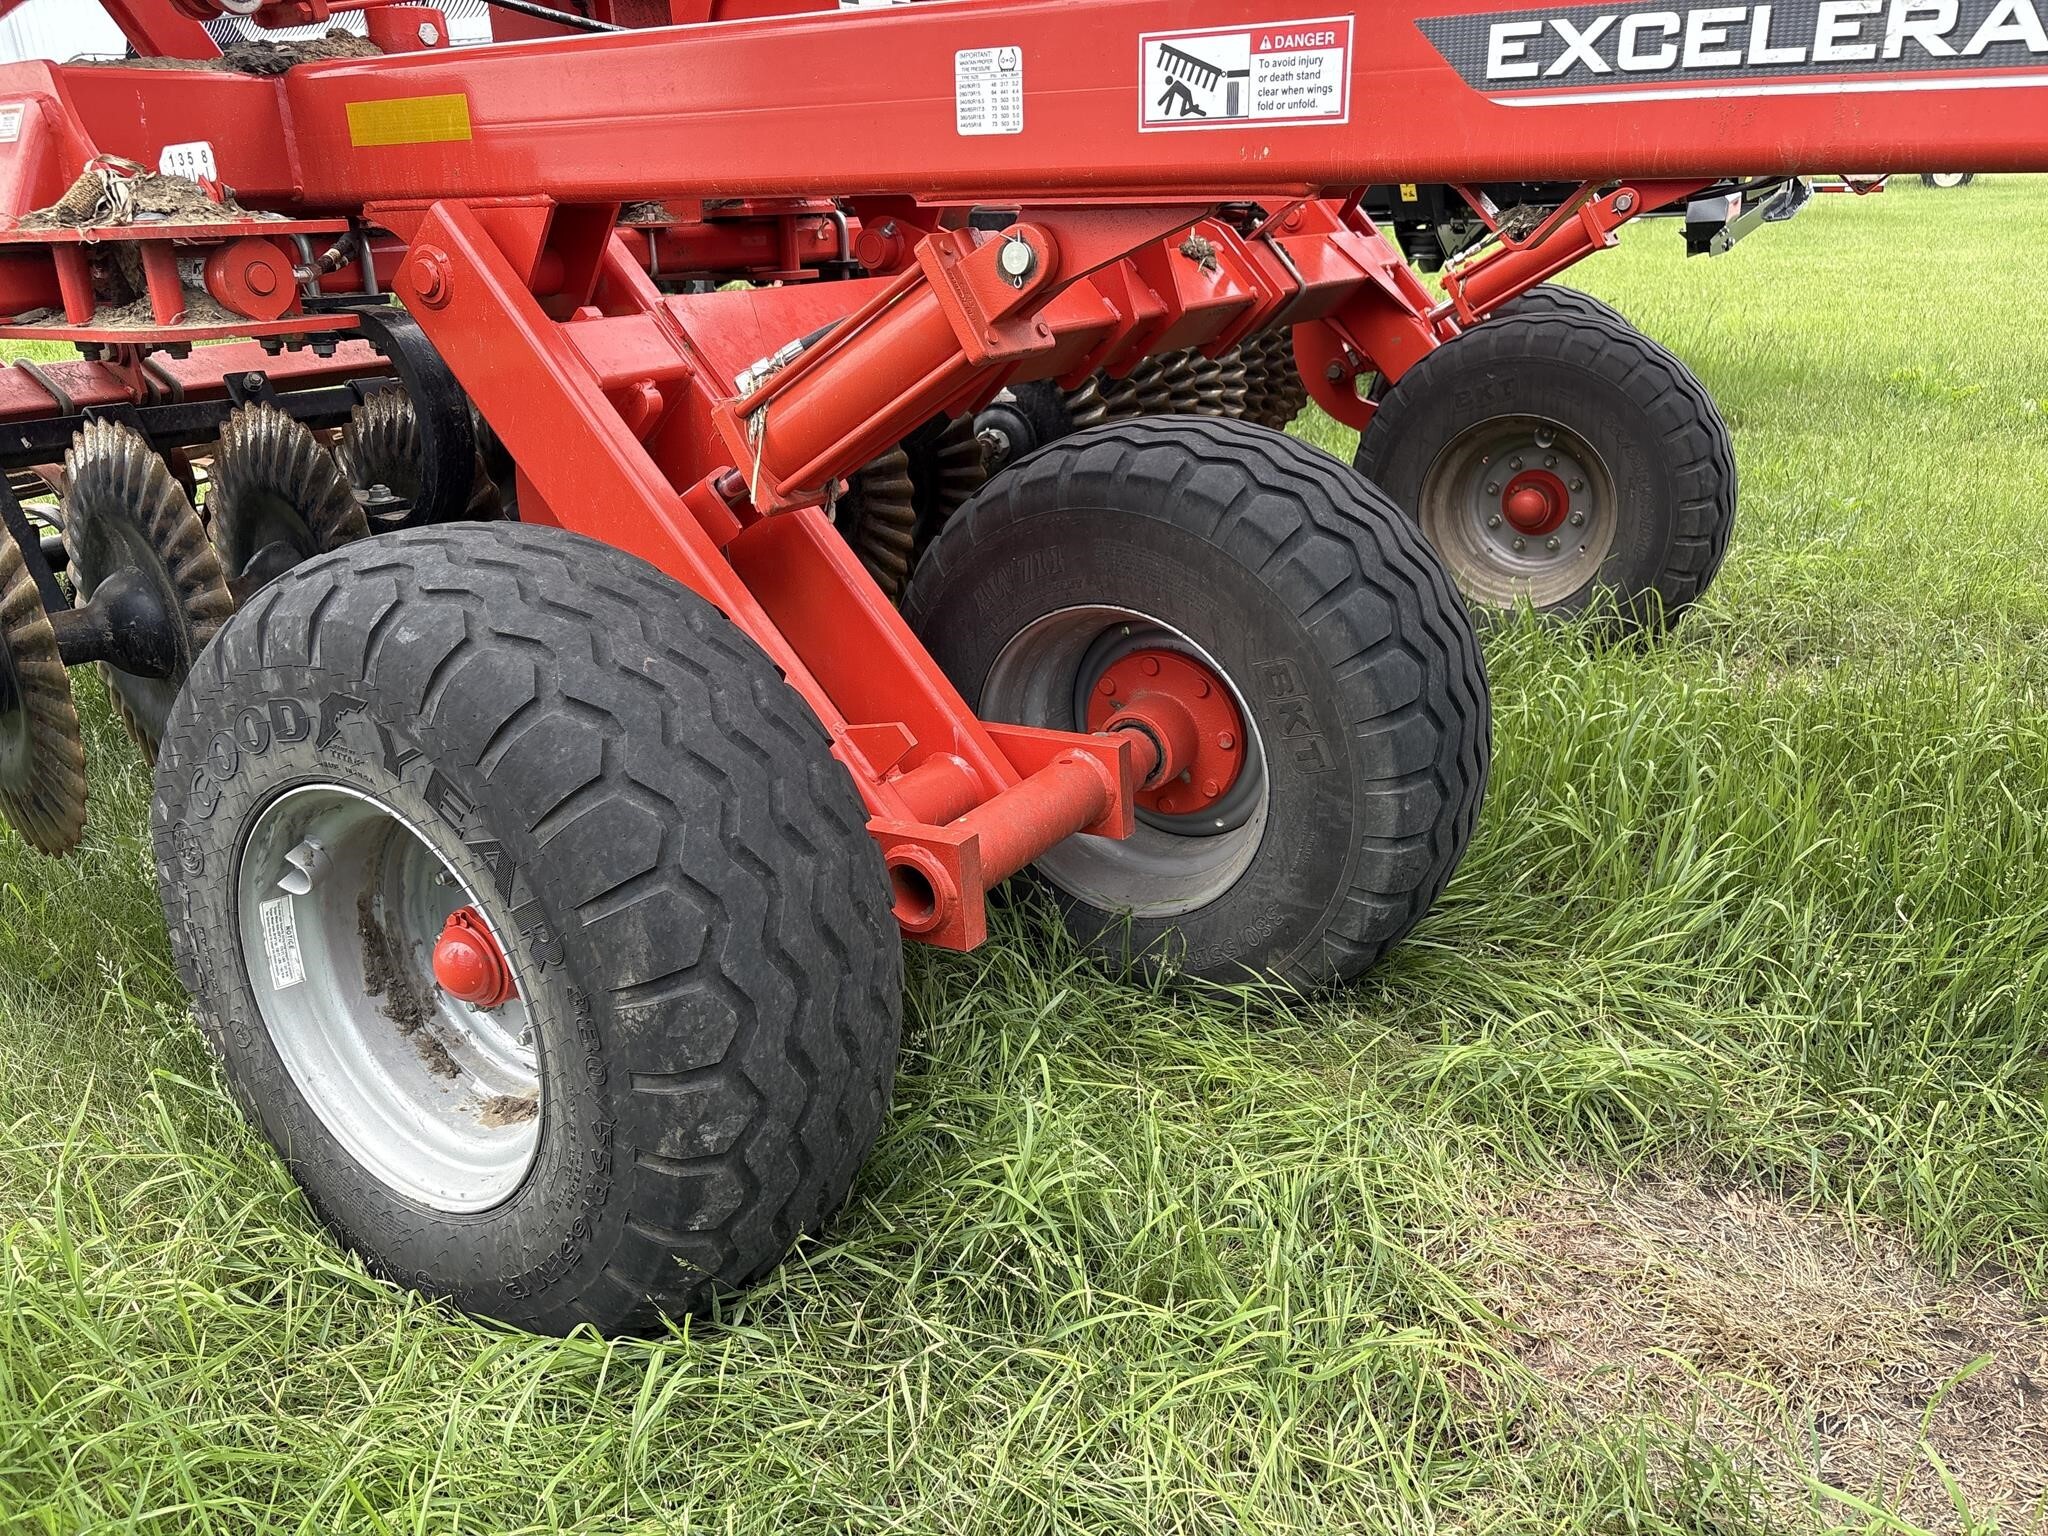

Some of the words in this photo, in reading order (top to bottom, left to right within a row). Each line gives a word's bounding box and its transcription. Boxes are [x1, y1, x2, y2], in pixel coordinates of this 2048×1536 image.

[1274, 31, 1335, 49] DANGER
[1259, 59, 1270, 69] To
[1272, 57, 1296, 68] avoid
[1299, 55, 1324, 69] injury
[1258, 75, 1268, 83] or
[1269, 71, 1294, 82] death
[1296, 69, 1321, 81] stand
[1257, 87, 1279, 97] clear
[1281, 85, 1305, 95] when
[1307, 84, 1333, 96] wings
[1257, 101, 1274, 111] fold
[1276, 102, 1286, 110] or
[1288, 98, 1318, 109] unfold.
[1255, 659, 1334, 773] BKT
[189, 694, 565, 973] GOODYEAR
